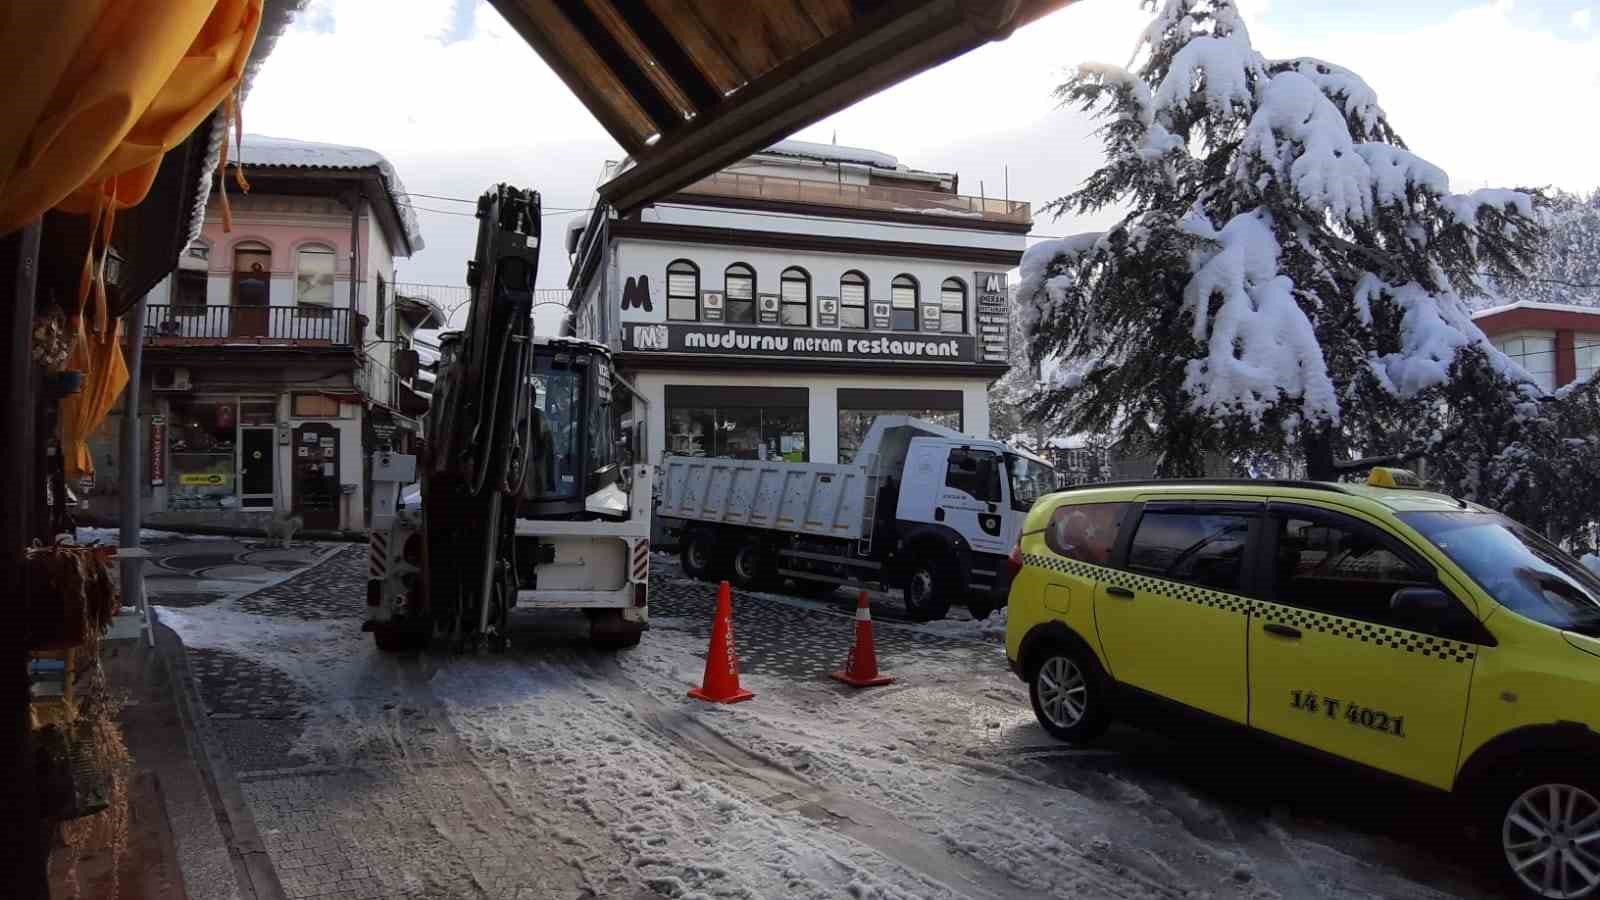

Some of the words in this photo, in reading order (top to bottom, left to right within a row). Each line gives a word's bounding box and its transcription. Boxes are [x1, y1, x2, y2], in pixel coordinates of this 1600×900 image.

[621, 275, 653, 312] M
[986, 275, 1000, 292] M
[685, 329, 789, 350] mudurnu
[793, 338, 842, 353] meram
[847, 337, 959, 357] restaurant
[1290, 689, 1319, 711] 14
[1323, 696, 1340, 718] T
[1345, 702, 1406, 738] 4021
